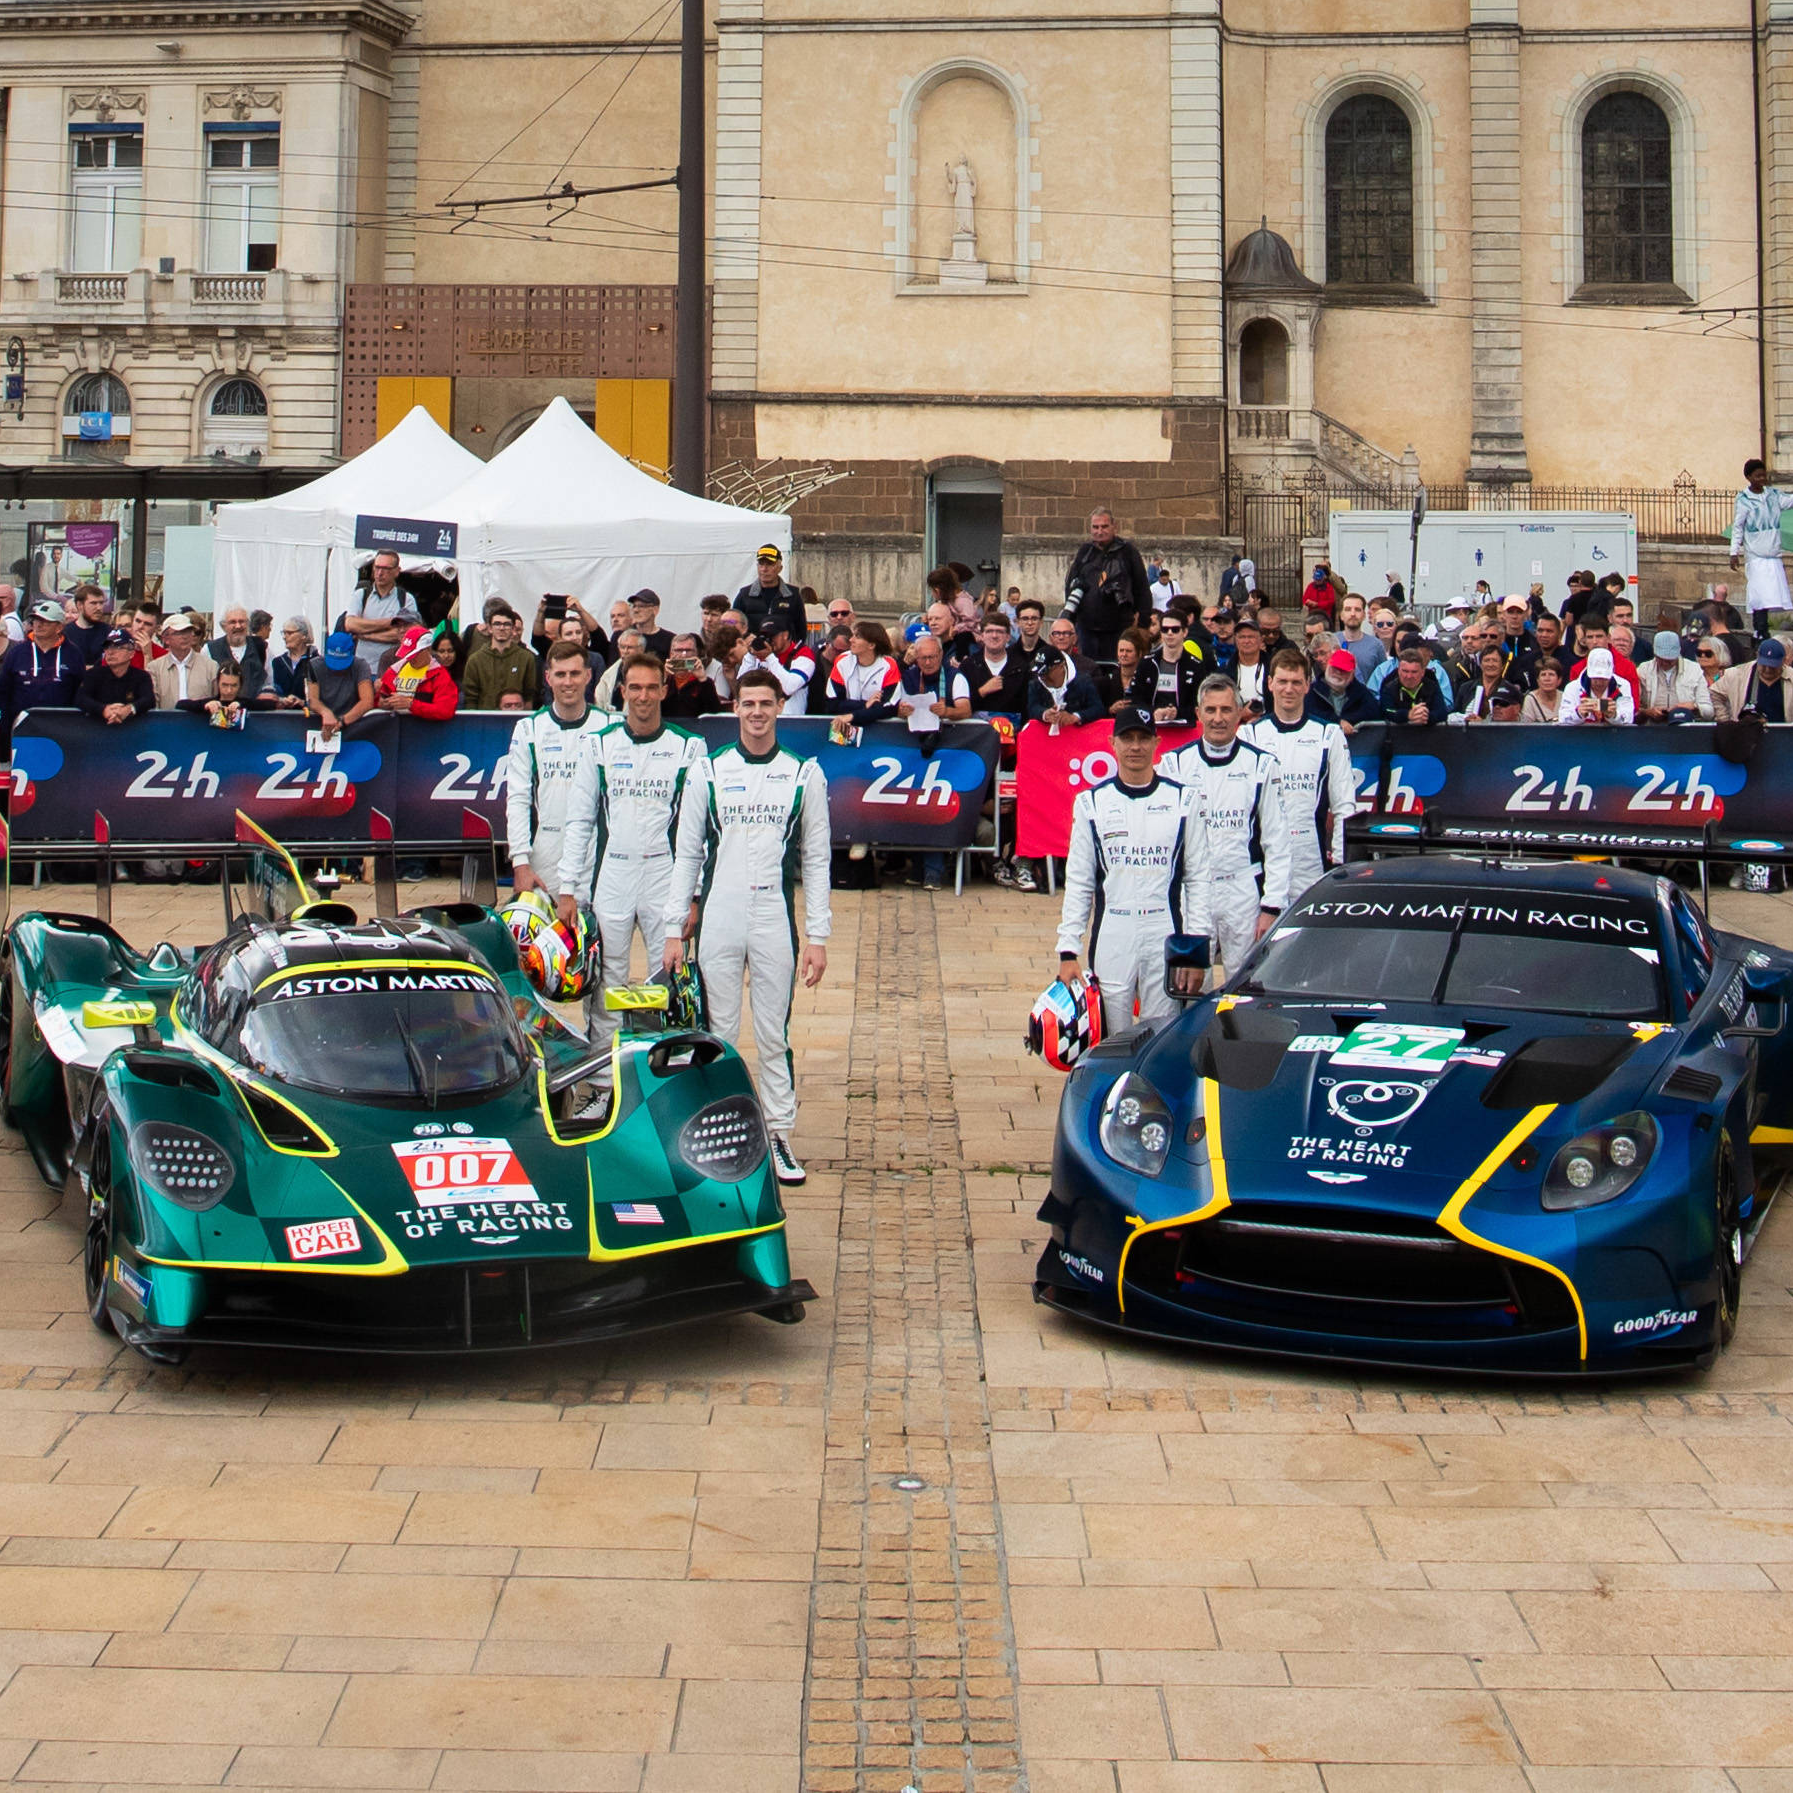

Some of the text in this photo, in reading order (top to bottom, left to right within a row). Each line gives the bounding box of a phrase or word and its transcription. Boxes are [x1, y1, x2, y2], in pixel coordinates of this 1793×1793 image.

[1518, 524, 1555, 533] Toilettes
[125, 751, 219, 799] 24h
[255, 751, 351, 799] 24h
[613, 778, 670, 789] THE HEART
[861, 757, 954, 806] 24h
[1283, 773, 1316, 783] HEART
[612, 788, 668, 798] OF RACING
[1284, 781, 1316, 791] ACING
[1506, 765, 1593, 811] 24h
[1627, 765, 1718, 811] 24h
[723, 805, 786, 814] THE HEART
[1211, 809, 1246, 819] HEART
[723, 815, 783, 825] OF RACING
[1206, 819, 1244, 829] RACING
[1445, 828, 1704, 848] Seattle Children's
[1125, 856, 1168, 866] RACING
[1132, 846, 1170, 856] HEART
[1295, 901, 1650, 935] ASTON MARTIN RACING
[272, 974, 497, 1000] ASTON MARTIN
[1348, 1032, 1450, 1057] 27
[1290, 1136, 1412, 1157] THE HEART
[1287, 1148, 1405, 1168] OF RACING
[414, 1153, 511, 1188] 007
[395, 1202, 568, 1224] THE HEART
[291, 1221, 351, 1238] HYPER
[405, 1216, 574, 1238] OF RACING
[295, 1232, 356, 1255] CAR
[1613, 1309, 1698, 1334] GOODYEAR
